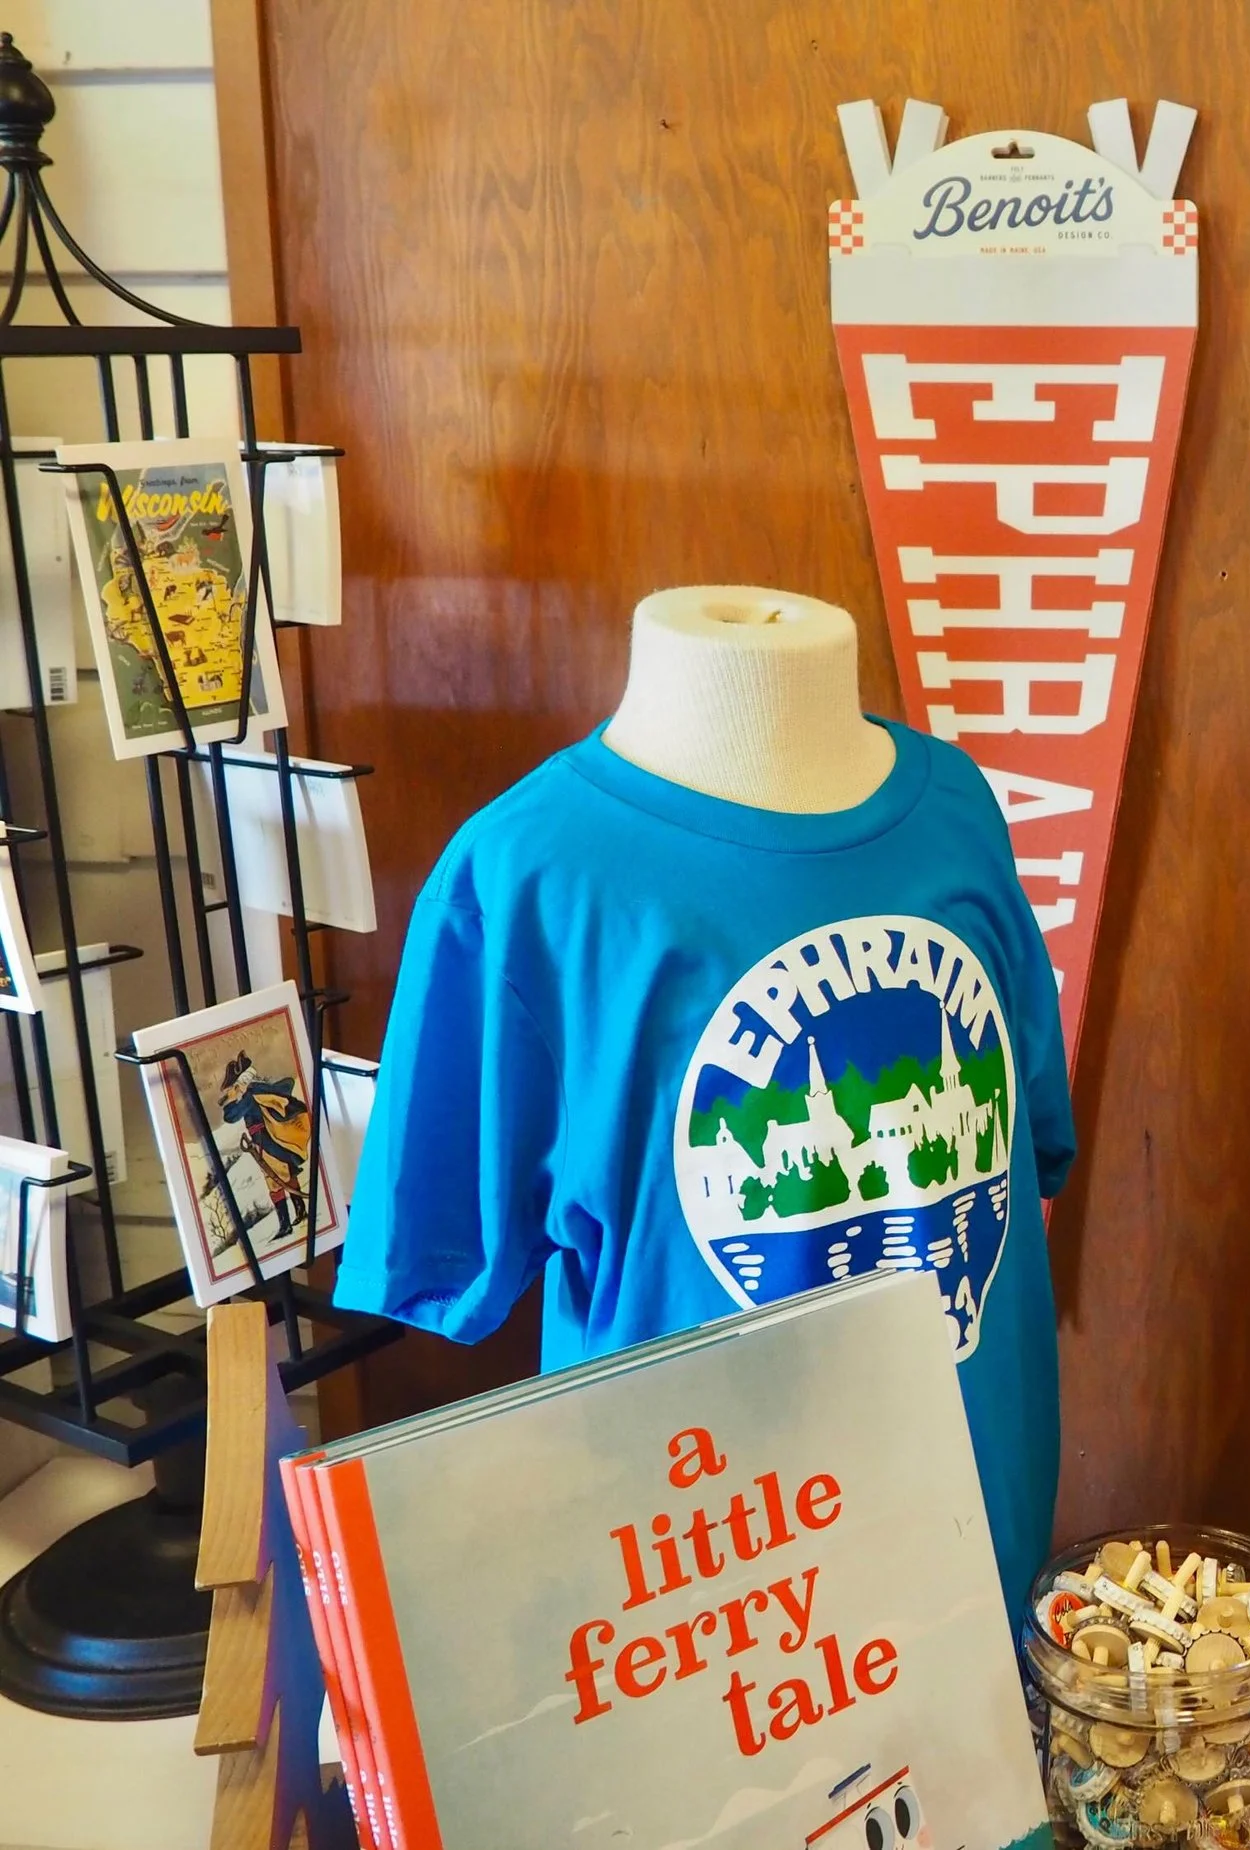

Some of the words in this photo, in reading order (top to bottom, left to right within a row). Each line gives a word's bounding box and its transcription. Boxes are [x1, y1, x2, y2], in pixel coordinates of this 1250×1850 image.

[913, 176, 1114, 240] Benoit's
[1058, 231, 1093, 239] DESIGN
[96, 481, 228, 522] Wisconsin
[710, 928, 997, 1090] EPHRAIM
[667, 1425, 728, 1490] a
[610, 1470, 843, 1612] little
[563, 1565, 821, 1727] ferry
[720, 1636, 900, 1758] tale
